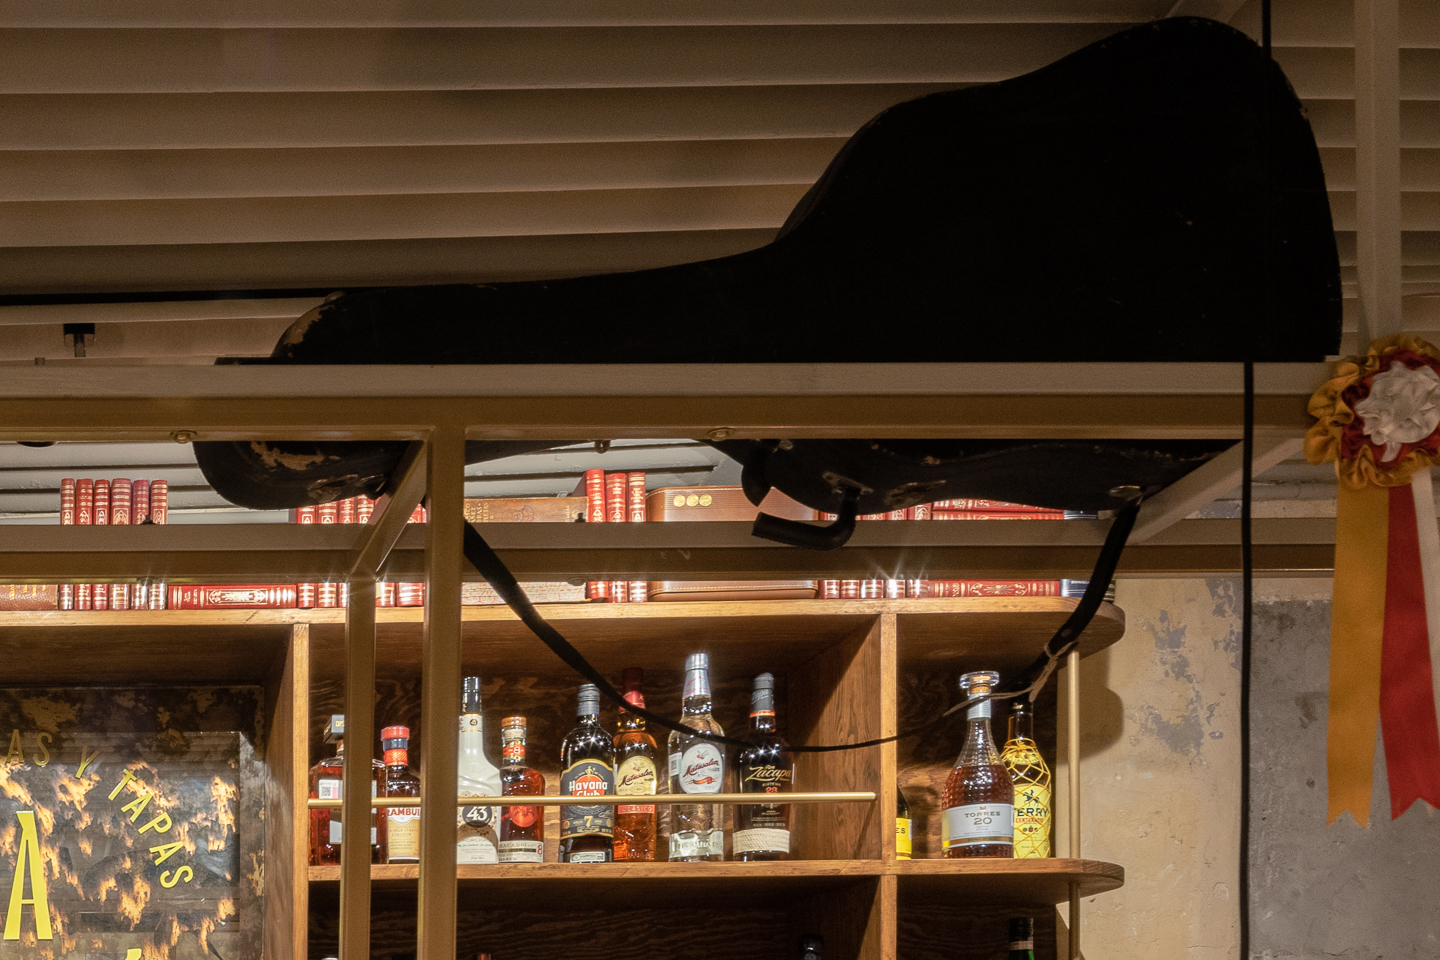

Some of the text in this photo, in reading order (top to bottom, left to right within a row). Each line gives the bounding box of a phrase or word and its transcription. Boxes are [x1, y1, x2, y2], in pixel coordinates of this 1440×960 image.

[745, 766, 792, 782] Zacapa
[569, 780, 608, 791] Havana
[76, 744, 101, 780] Y
[107, 769, 194, 890] TAPAS
[467, 807, 488, 821] 43
[584, 815, 594, 827] 7
[973, 817, 992, 825] 20
